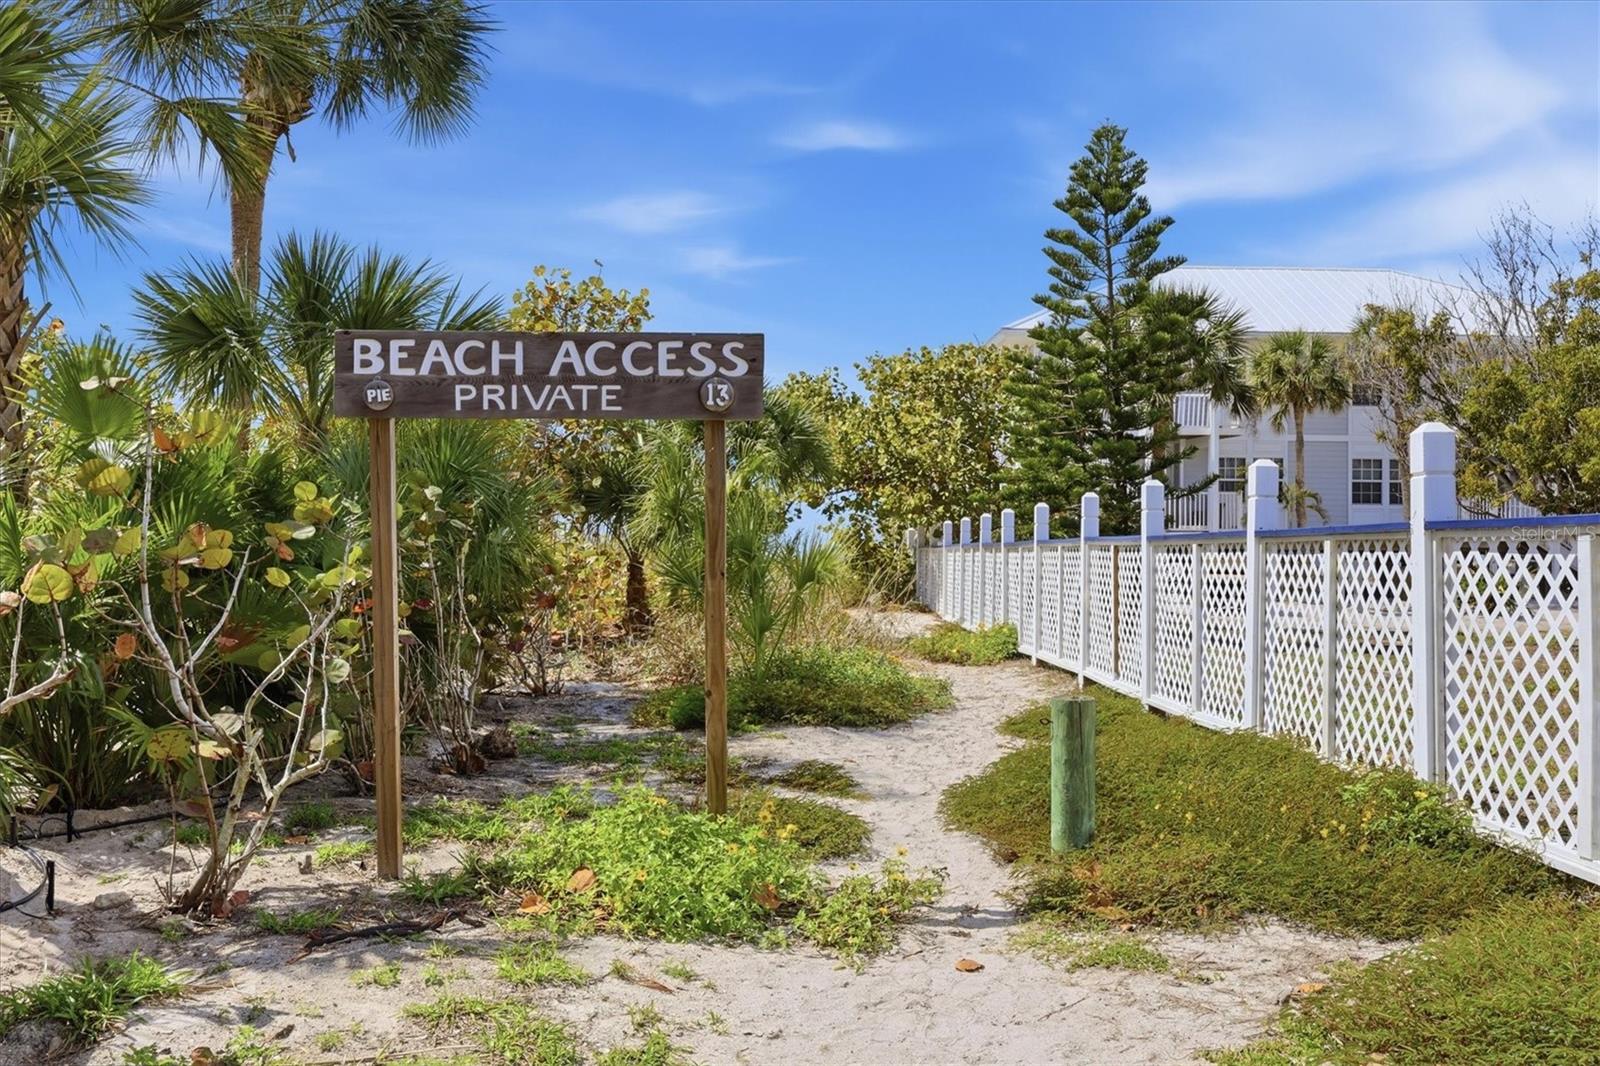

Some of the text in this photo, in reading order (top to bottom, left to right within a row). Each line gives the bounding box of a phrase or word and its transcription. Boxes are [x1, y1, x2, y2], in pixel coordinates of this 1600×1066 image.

[353, 339, 749, 377] BEACH ACCESS
[366, 389, 391, 402] PIE
[455, 384, 622, 411] PRIVATE
[706, 383, 729, 406] 13
